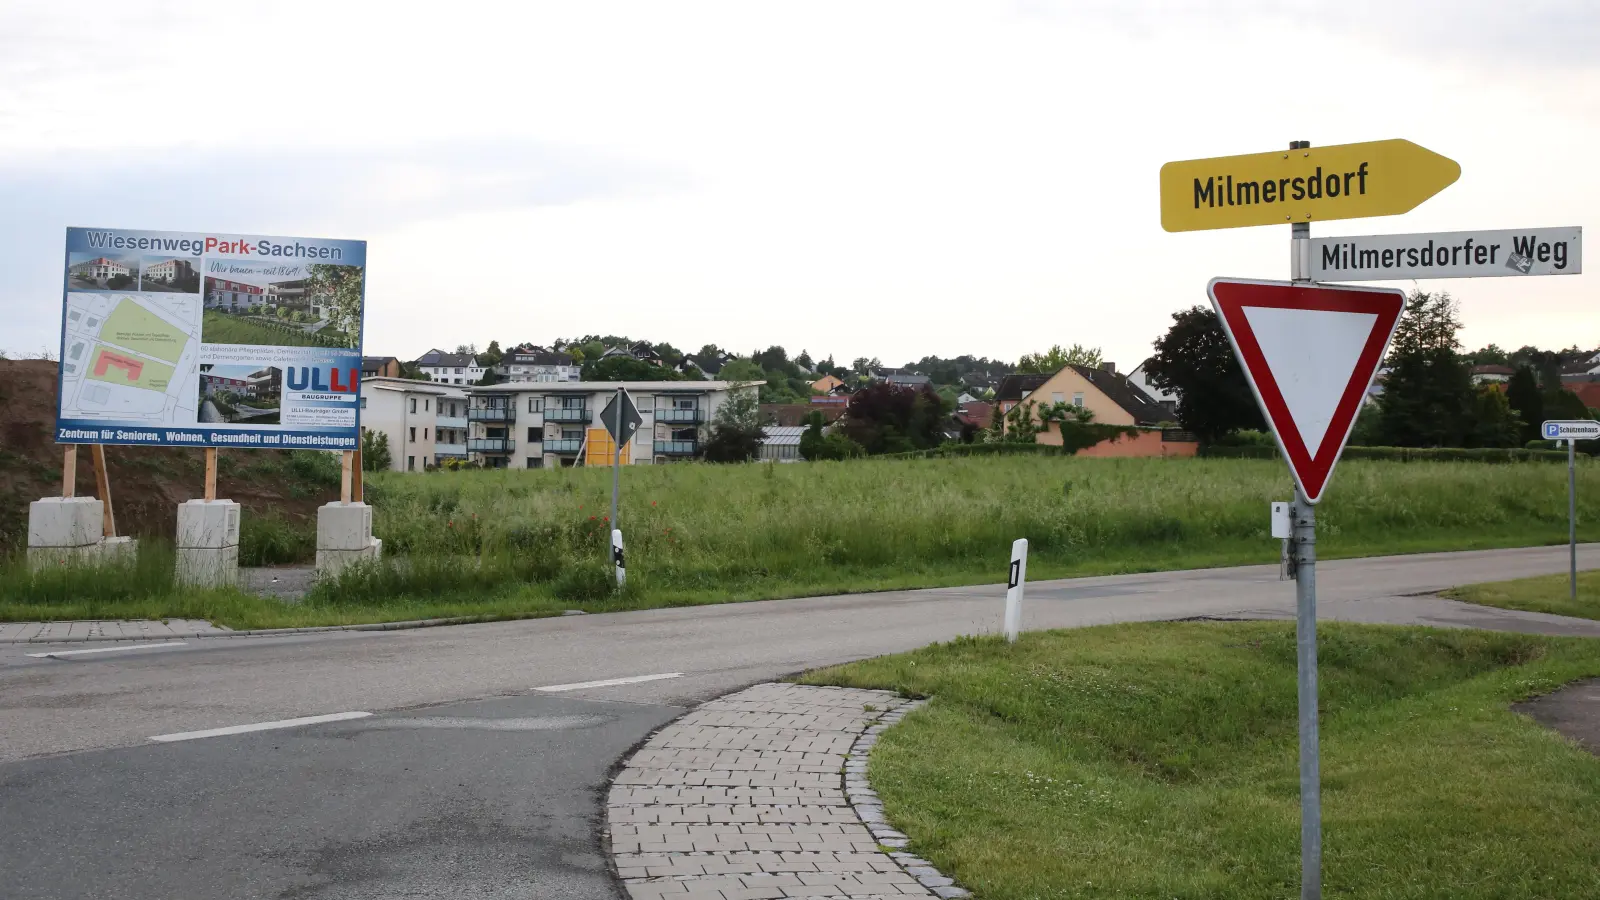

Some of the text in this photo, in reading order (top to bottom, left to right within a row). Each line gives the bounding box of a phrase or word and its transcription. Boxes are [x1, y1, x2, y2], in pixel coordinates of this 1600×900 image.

[1194, 162, 1368, 209] Milmersdorf
[88, 231, 342, 260] WiesenwegPark-Sachsen
[1322, 238, 1500, 270] Milmersdorfer
[1513, 235, 1567, 270] Weg
[210, 261, 227, 273] Wir
[229, 265, 253, 274] bauen
[263, 265, 278, 276] seit
[287, 366, 358, 393] ULLI
[59, 428, 355, 446] Zentrum für Senioren, Wohnen, Gesundheit und Dienstleistungen
